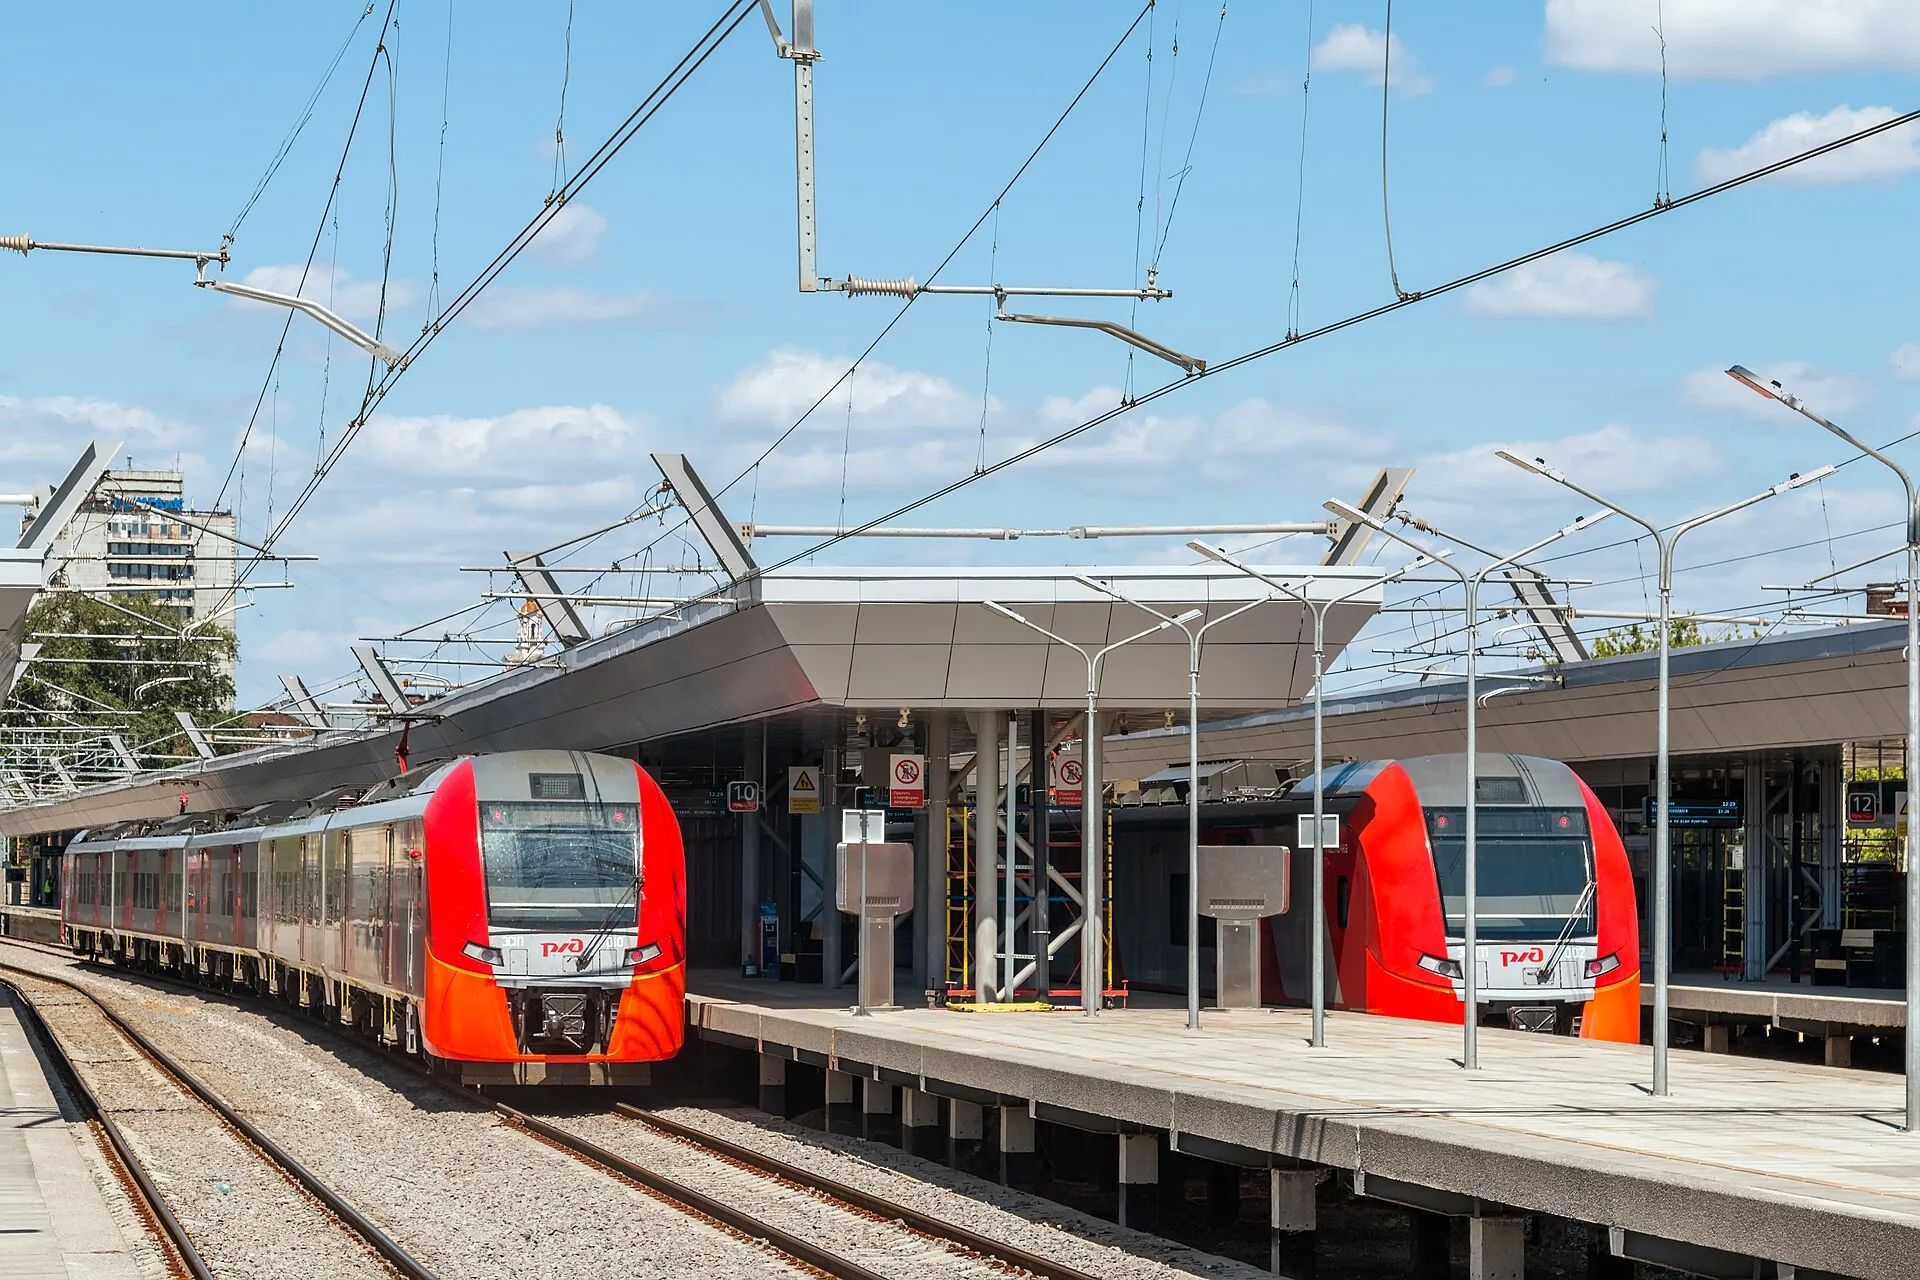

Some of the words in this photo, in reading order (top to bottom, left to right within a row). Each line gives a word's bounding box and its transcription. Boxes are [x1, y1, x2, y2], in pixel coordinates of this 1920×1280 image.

[734, 785, 755, 801] 10
[1853, 796, 1872, 812] 12
[606, 937, 623, 948] 010
